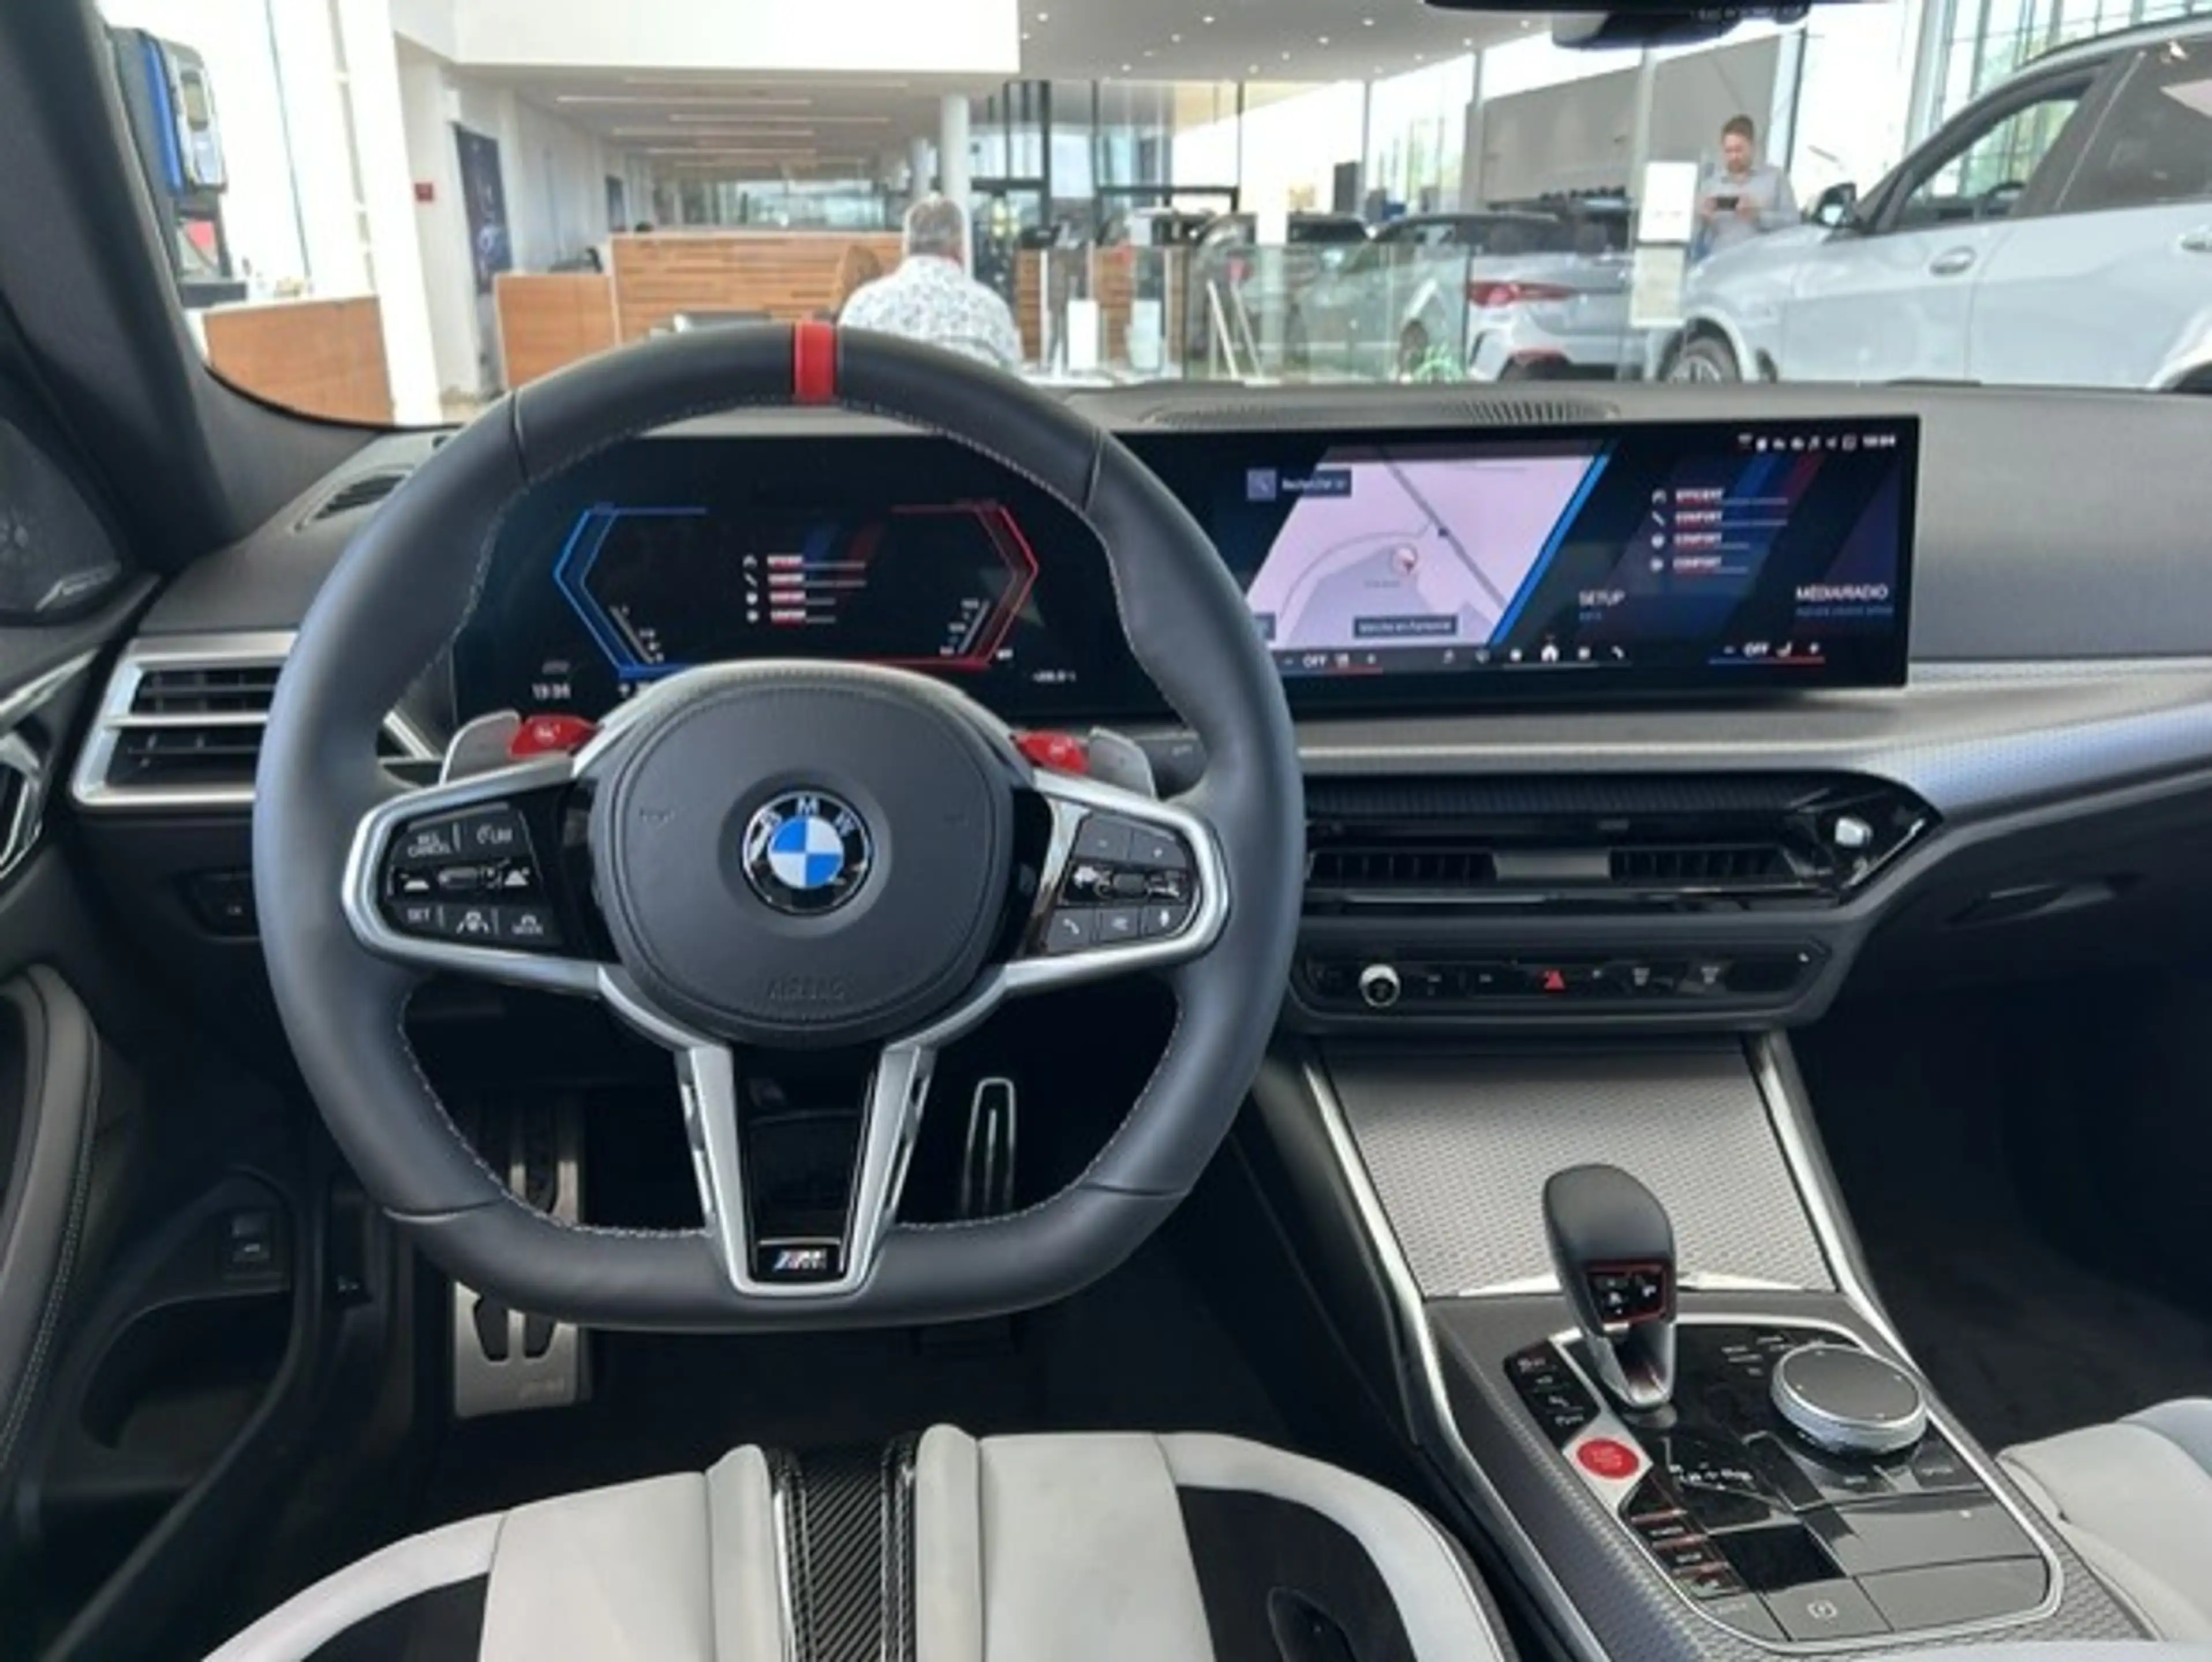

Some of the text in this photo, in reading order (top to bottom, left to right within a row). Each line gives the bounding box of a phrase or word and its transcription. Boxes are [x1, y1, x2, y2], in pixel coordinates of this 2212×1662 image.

[1579, 589, 1626, 607] SETUP
[1743, 642, 1769, 657] OFF
[1302, 653, 1327, 668] OFF
